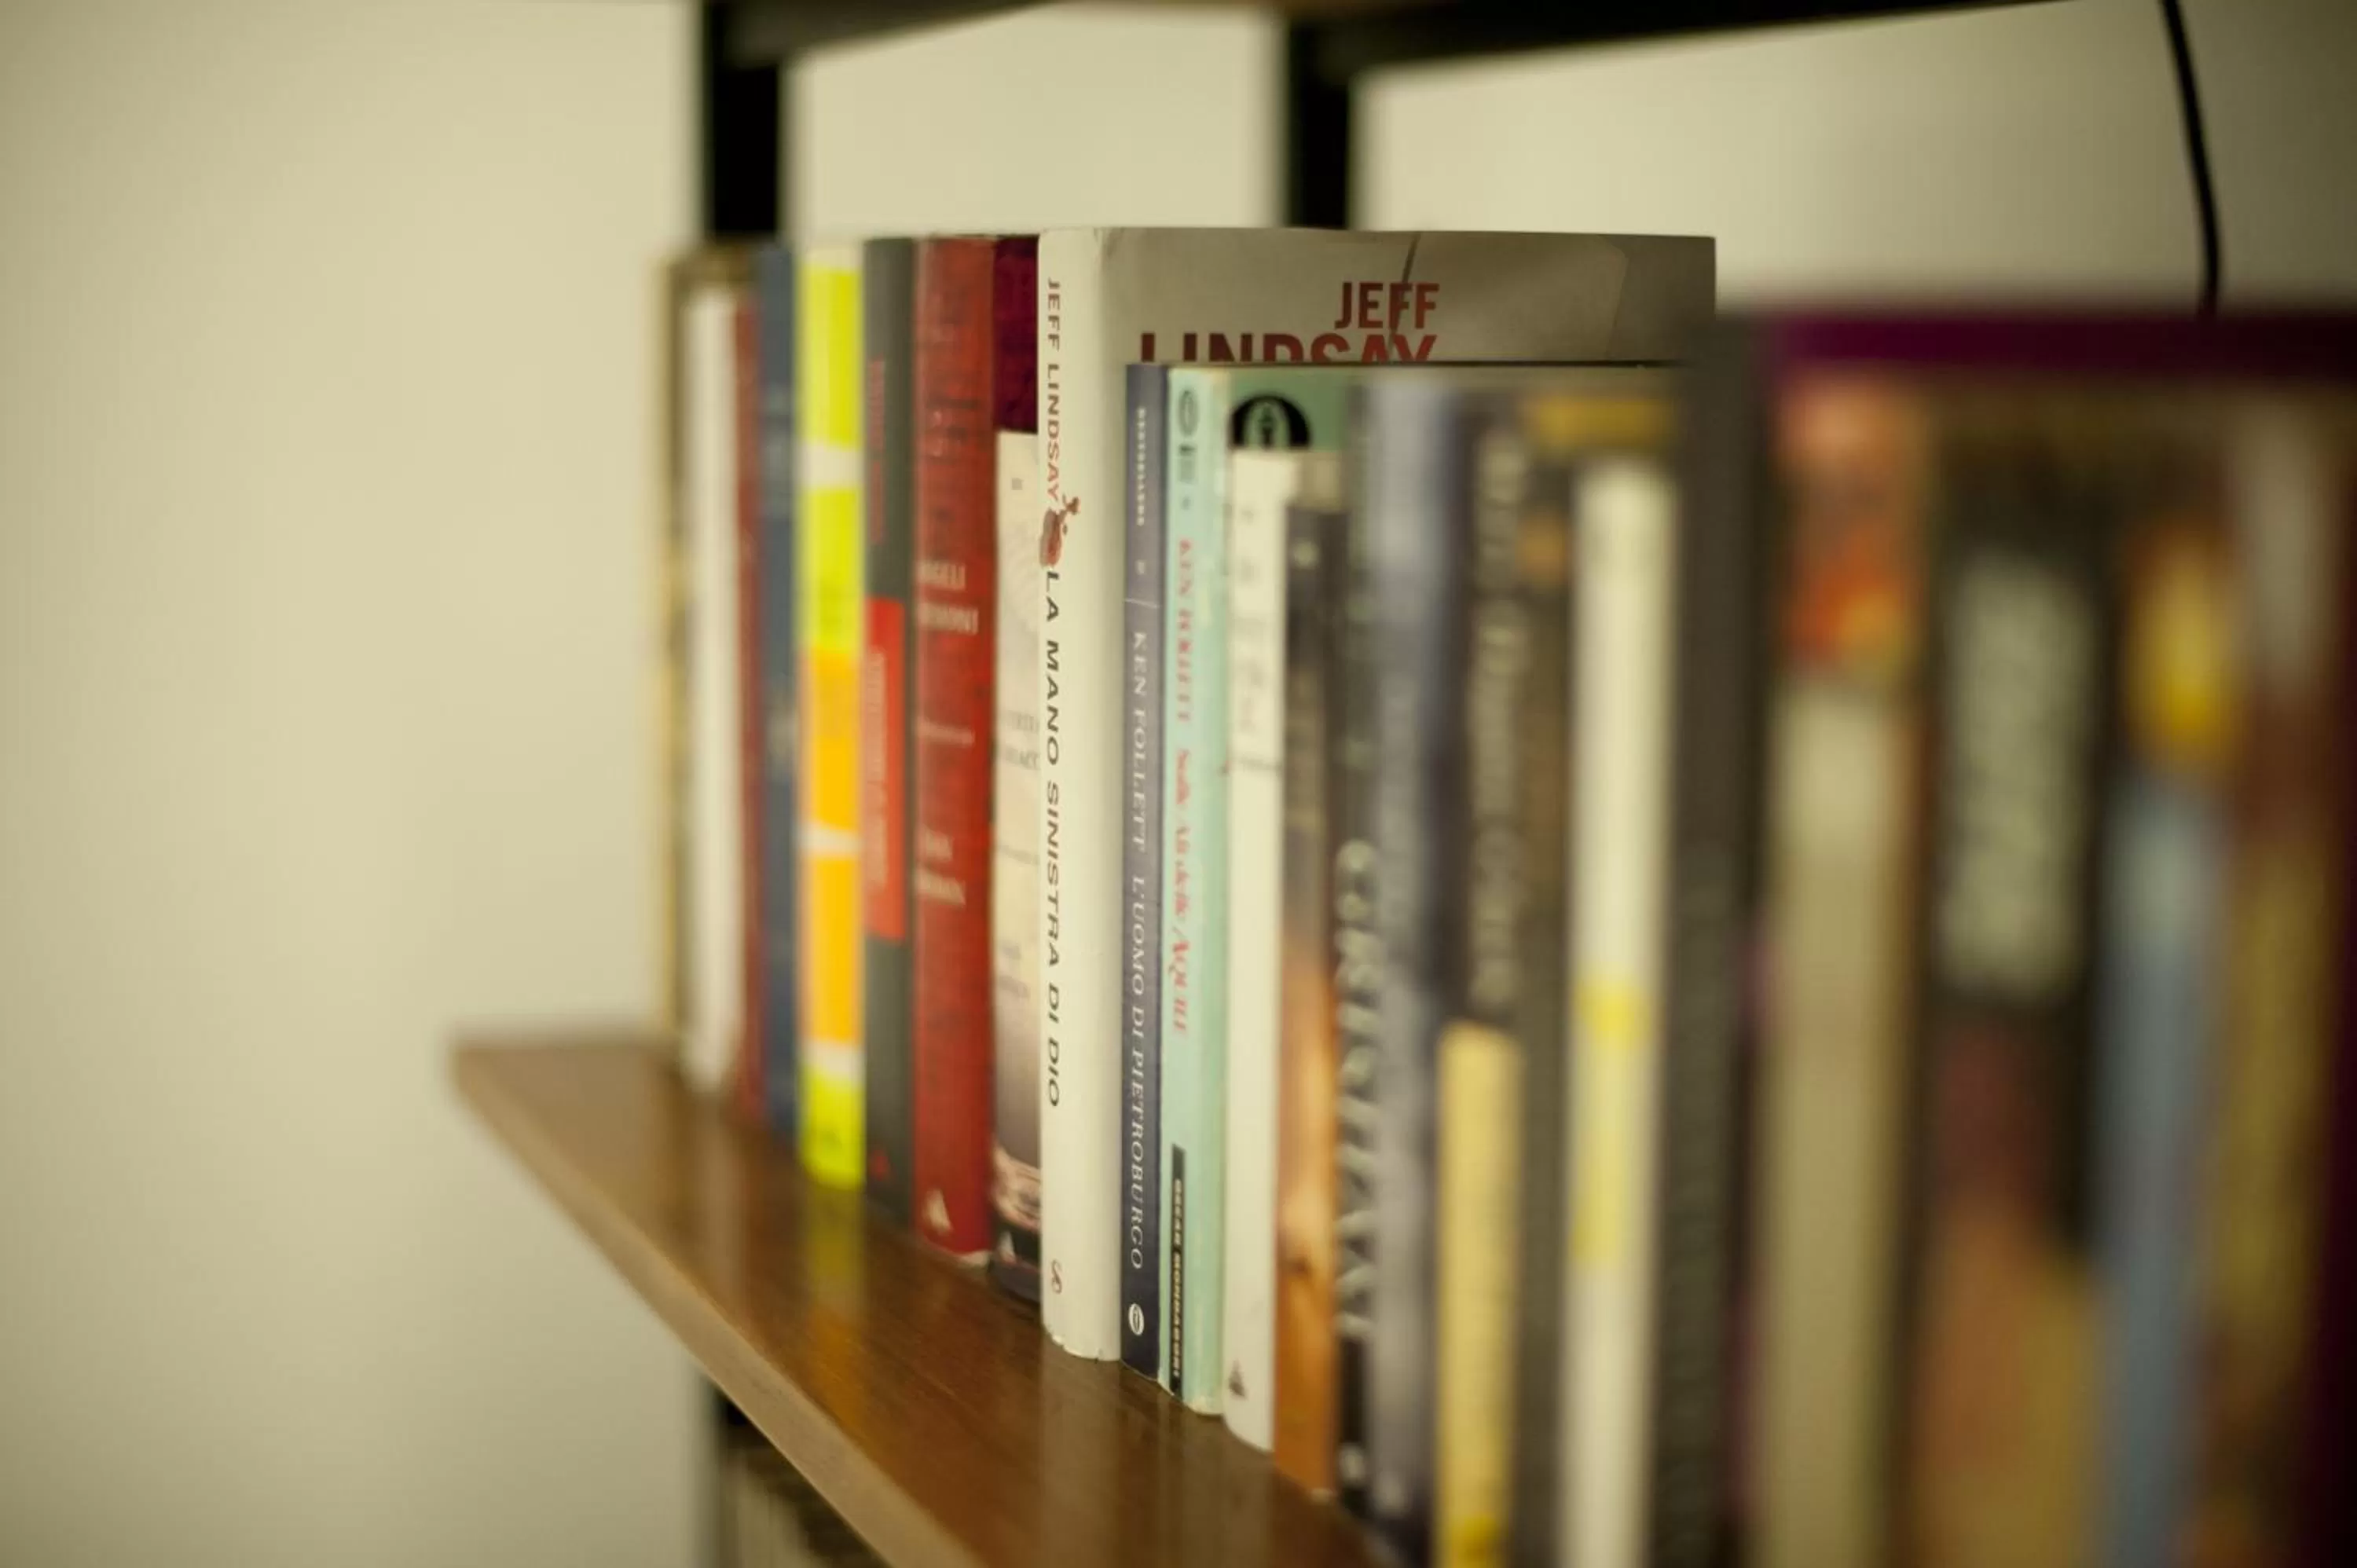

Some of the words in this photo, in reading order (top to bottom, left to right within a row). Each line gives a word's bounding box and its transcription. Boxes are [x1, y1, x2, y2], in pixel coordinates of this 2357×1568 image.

[1047, 278, 1061, 351] JEFF
[1335, 281, 1440, 330] JEFF
[1047, 363, 1060, 501] LINDSAY
[1046, 570, 1060, 622] LA
[1133, 631, 1147, 697] KEN
[1046, 639, 1060, 765] MANO
[1132, 709, 1146, 855] FOLLETT
[1047, 780, 1060, 967] SINISTRA
[1131, 874, 1146, 996] L'UOMO
[1047, 981, 1060, 1024] DI
[1131, 1006, 1145, 1039] DI
[1047, 1035, 1060, 1108] DIO
[1130, 1045, 1145, 1269] PIETROBURGO
